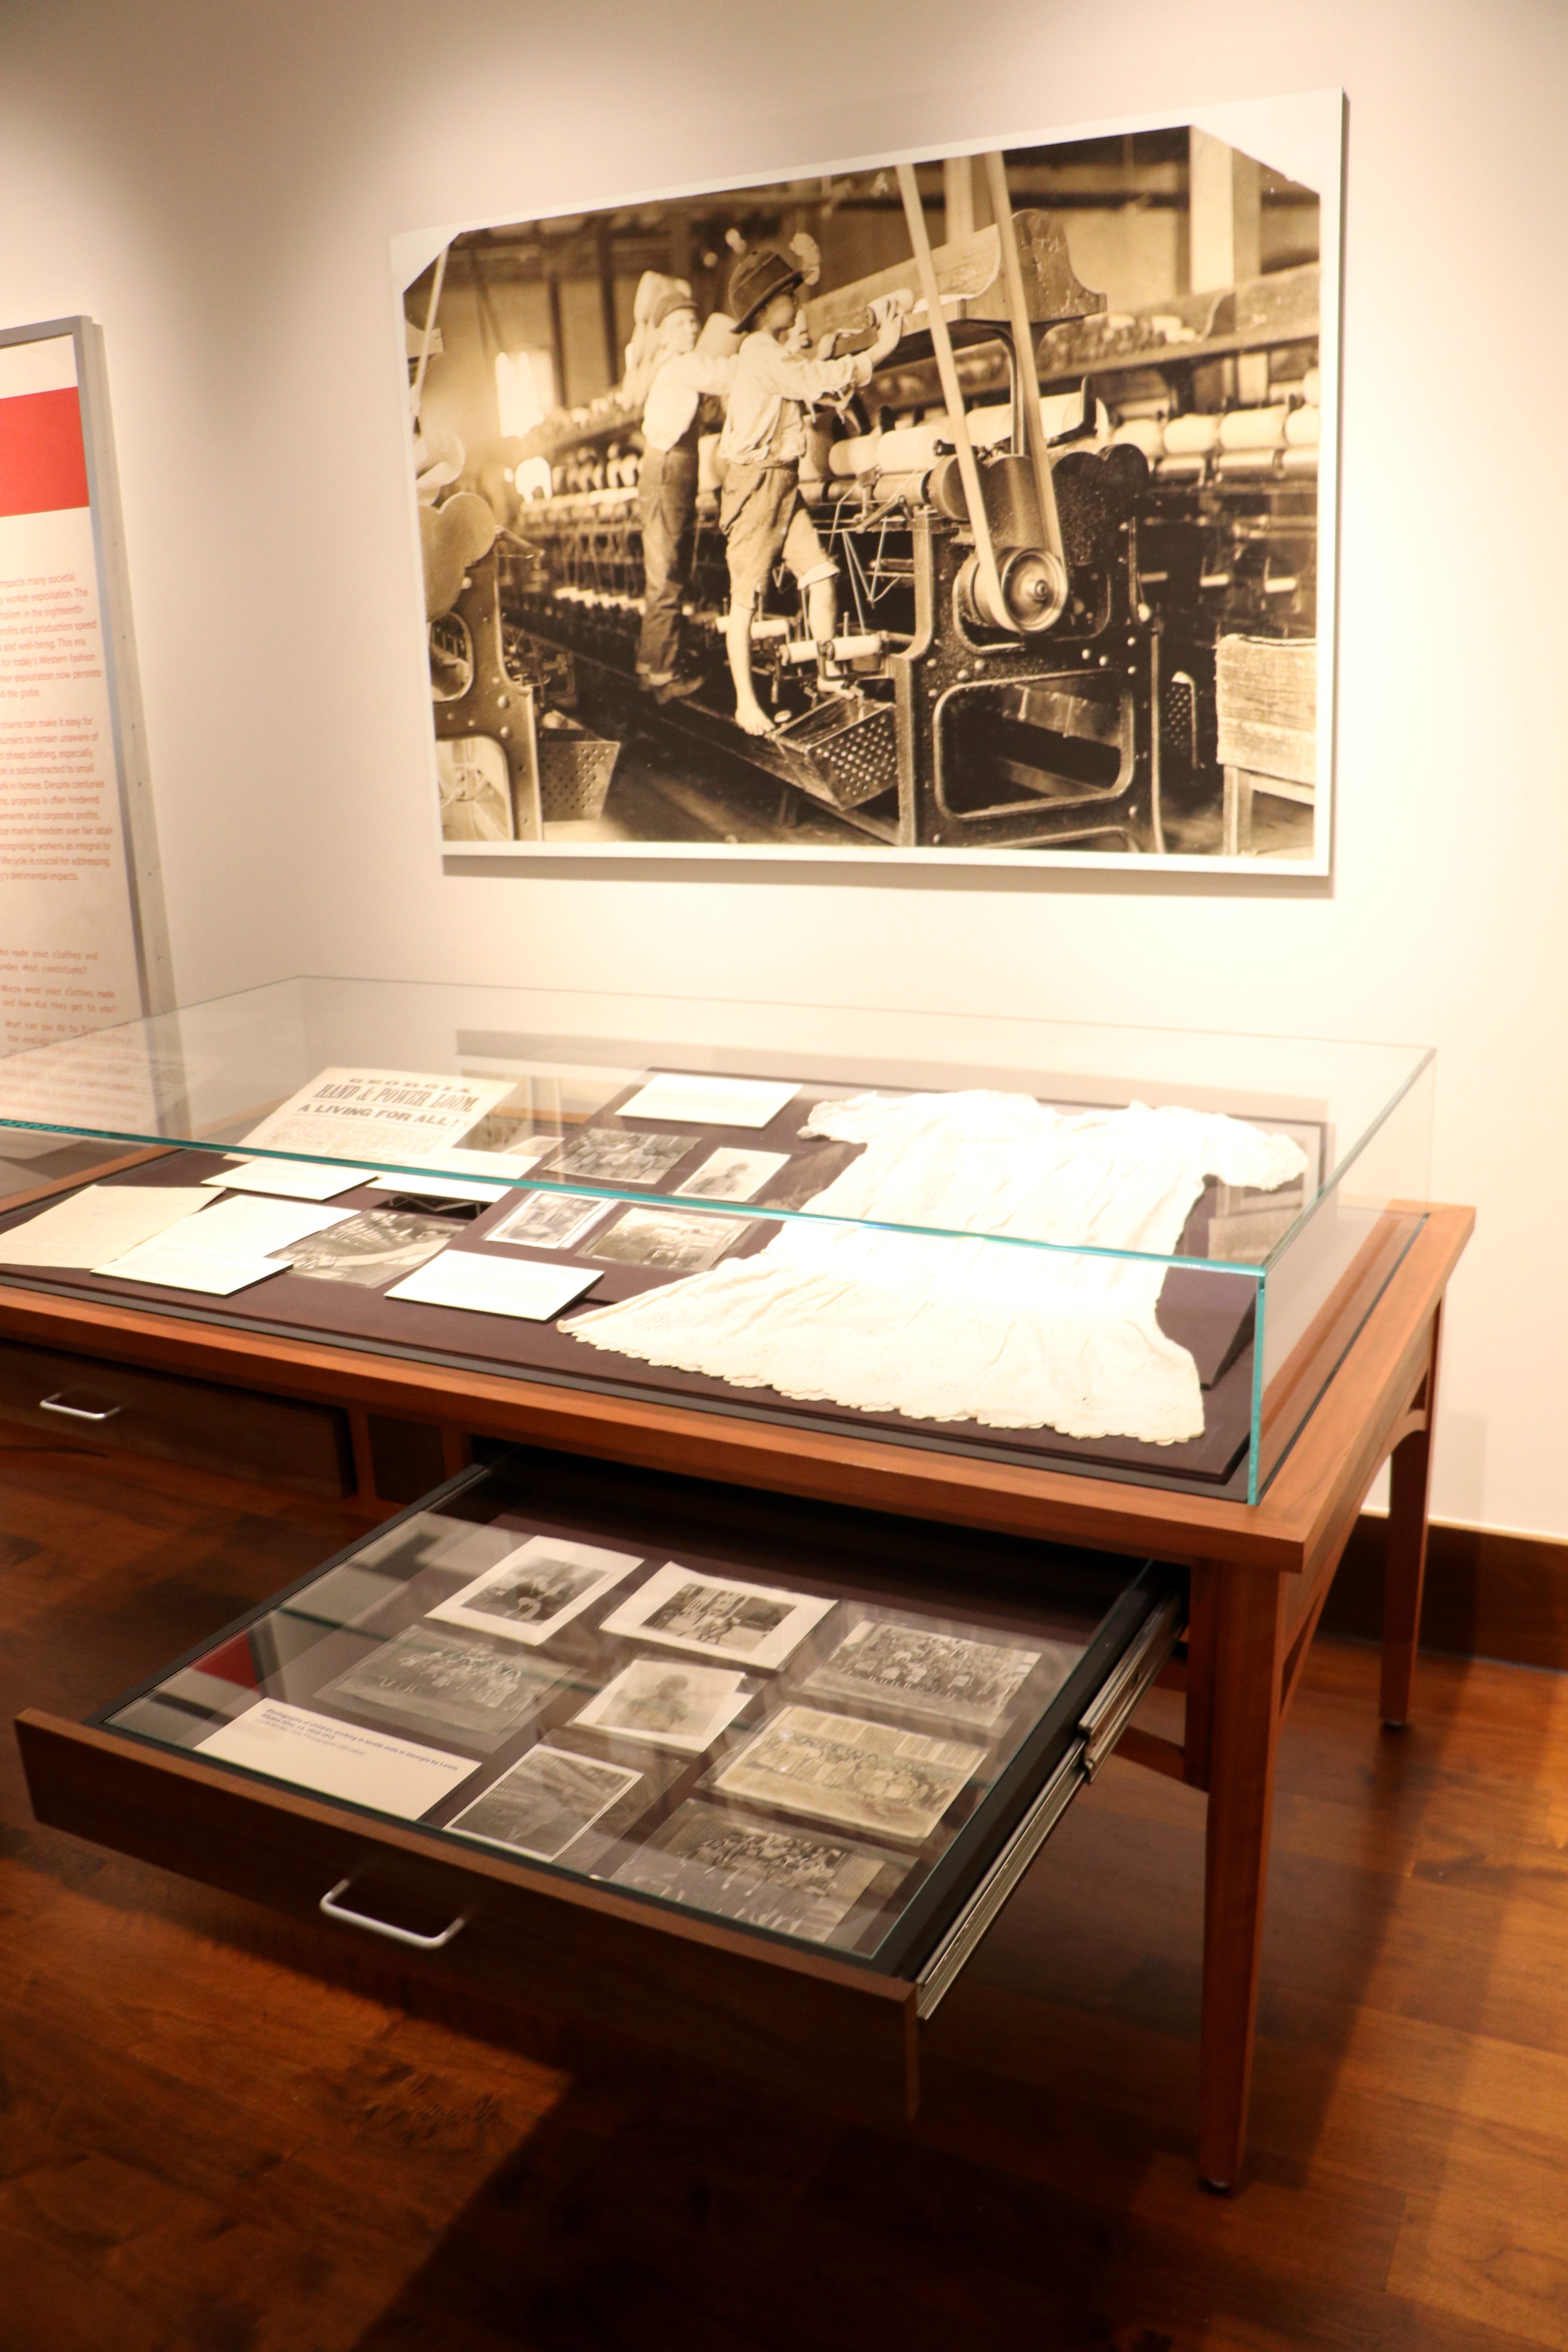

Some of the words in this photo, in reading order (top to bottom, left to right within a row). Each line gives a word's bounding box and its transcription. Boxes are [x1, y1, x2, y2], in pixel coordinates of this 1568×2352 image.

[27, 577, 46, 587] many
[48, 572, 76, 584] societal
[6, 594, 29, 603] worker
[74, 588, 89, 597] The
[20, 625, 33, 634] and
[35, 623, 73, 634] production
[75, 620, 96, 632] speed
[4, 641, 17, 651] and
[57, 638, 73, 647] This
[39, 656, 68, 664] Western
[69, 653, 96, 662] fashion
[15, 671, 54, 683] exploitation
[73, 670, 101, 681] persists
[38, 718, 57, 727] make
[65, 719, 82, 728] easy
[34, 733, 58, 743] remain
[5, 751, 26, 760] cheap
[59, 748, 94, 759] especially
[17, 765, 65, 775] subcontracted
[76, 764, 94, 773] small
[44, 780, 71, 791] Despite
[72, 779, 105, 789] centuries
[11, 798, 40, 807] progress
[49, 795, 67, 804] often
[68, 794, 100, 804] hindered
[27, 811, 40, 820] and
[41, 812, 74, 821] corporate
[11, 826, 34, 835] market
[36, 825, 64, 835] freedom
[95, 826, 113, 835] labor
[38, 842, 64, 850] workers
[36, 857, 59, 865] crucial
[71, 856, 110, 867] addressing
[11, 871, 48, 880] detrimental
[52, 950, 82, 959] clothes
[85, 952, 98, 960] and
[65, 987, 94, 997] clothes
[98, 990, 115, 998] made
[51, 1001, 67, 1011] they
[71, 1004, 83, 1013] get
[349, 1078, 472, 1093] GEORGIA
[313, 1084, 362, 1098] HAND
[356, 1087, 375, 1101] &
[372, 1088, 432, 1107] POWER
[297, 1103, 311, 1112] A
[314, 1104, 373, 1116] LIVING
[374, 1110, 412, 1121] FOR
